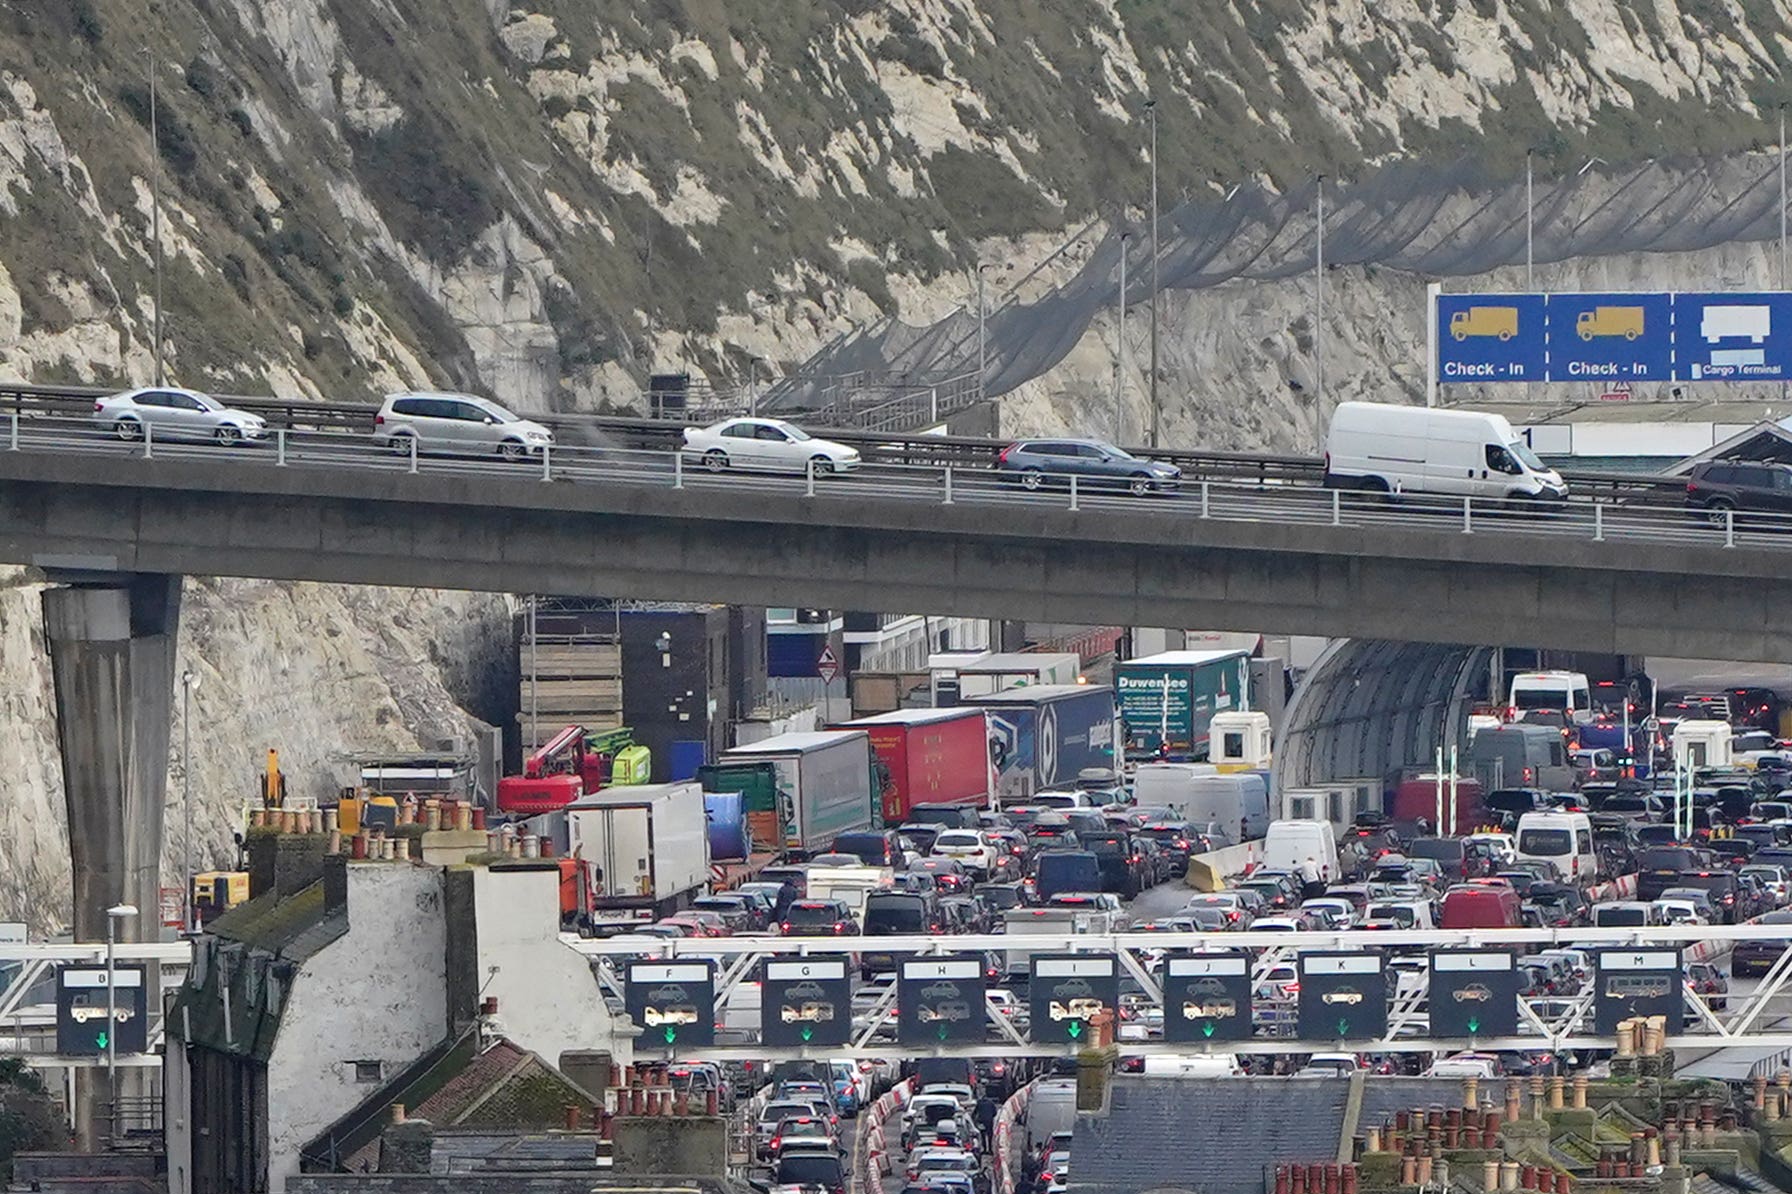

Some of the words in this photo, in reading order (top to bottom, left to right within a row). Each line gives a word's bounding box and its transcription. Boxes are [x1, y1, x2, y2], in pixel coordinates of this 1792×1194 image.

[1444, 361, 1495, 376] Check
[1509, 362, 1524, 375] In
[1568, 361, 1618, 375] Check
[1633, 362, 1648, 375] In
[1703, 364, 1735, 376] Cargo
[1737, 364, 1781, 375] Terminal
[1338, 961, 1345, 969] K
[1469, 957, 1476, 968] L
[1633, 956, 1644, 966] M
[665, 968, 672, 979] F
[937, 965, 947, 975] H
